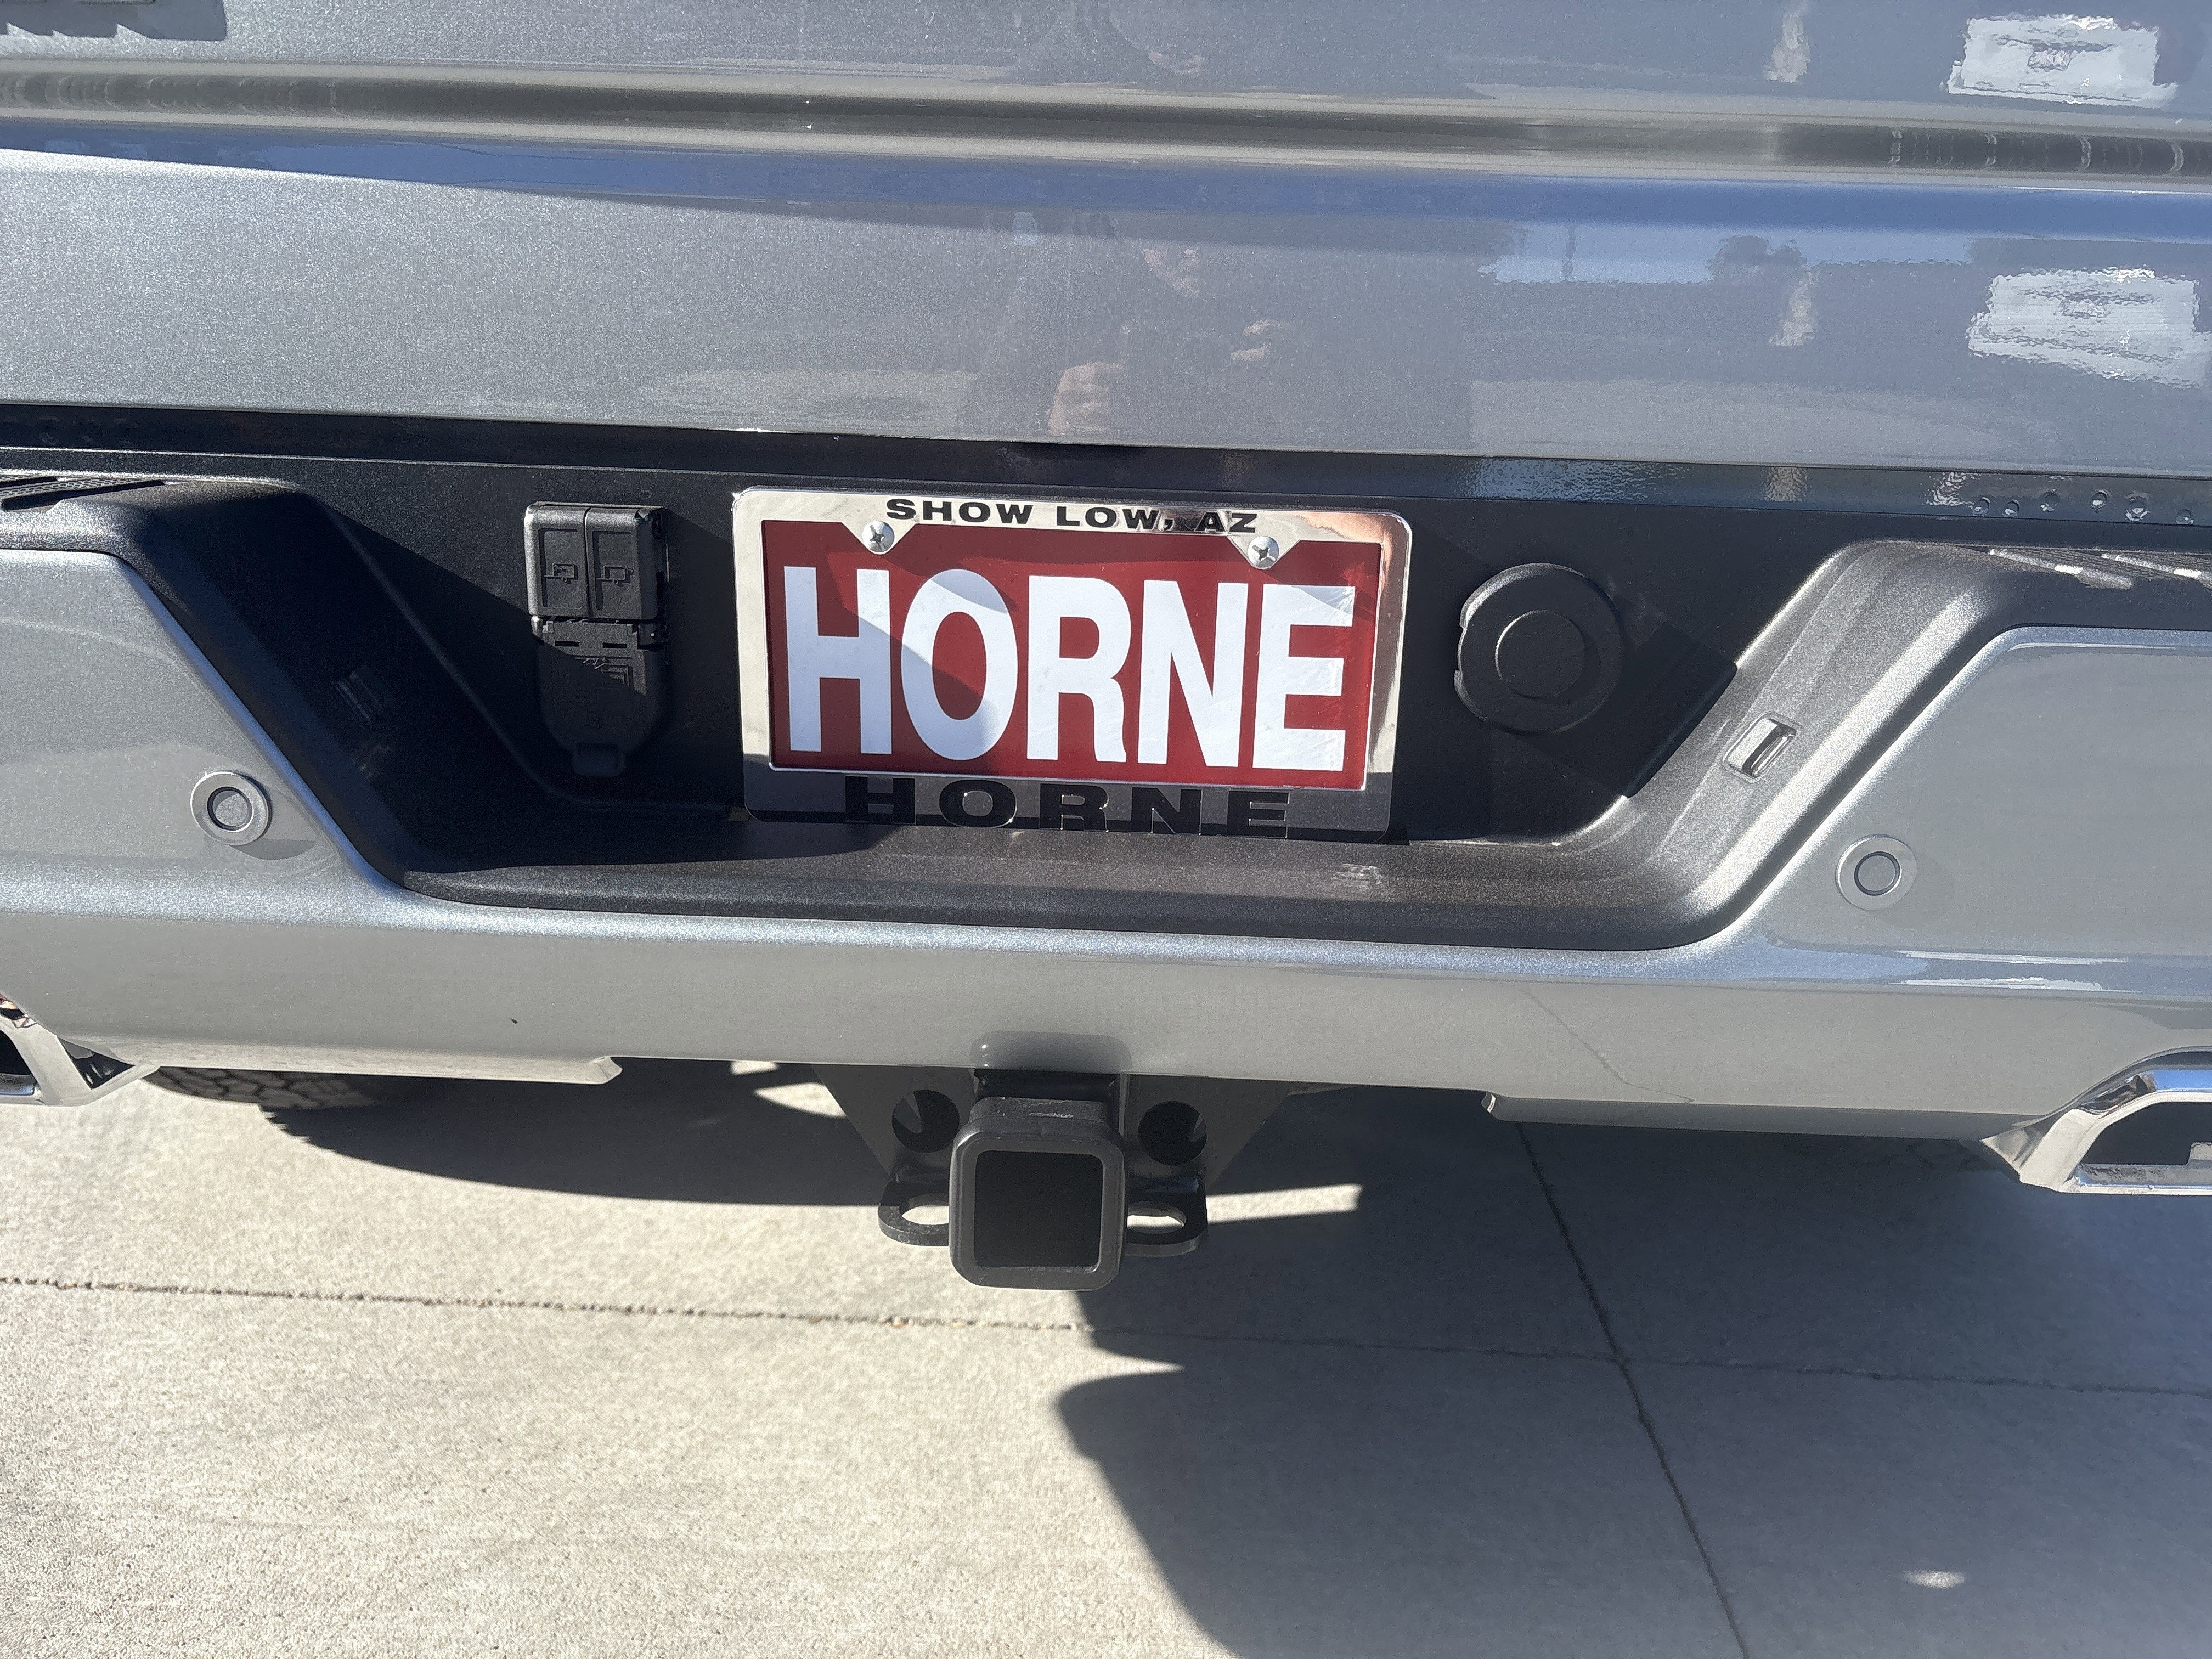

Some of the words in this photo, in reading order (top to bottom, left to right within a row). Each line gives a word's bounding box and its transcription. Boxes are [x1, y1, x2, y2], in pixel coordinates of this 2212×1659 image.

[887, 499, 1034, 524] SHOW
[1057, 506, 1175, 531] LOW,
[1195, 512, 1257, 533] AZ
[784, 566, 1356, 771] HORNE
[845, 776, 1290, 838] HORNE
